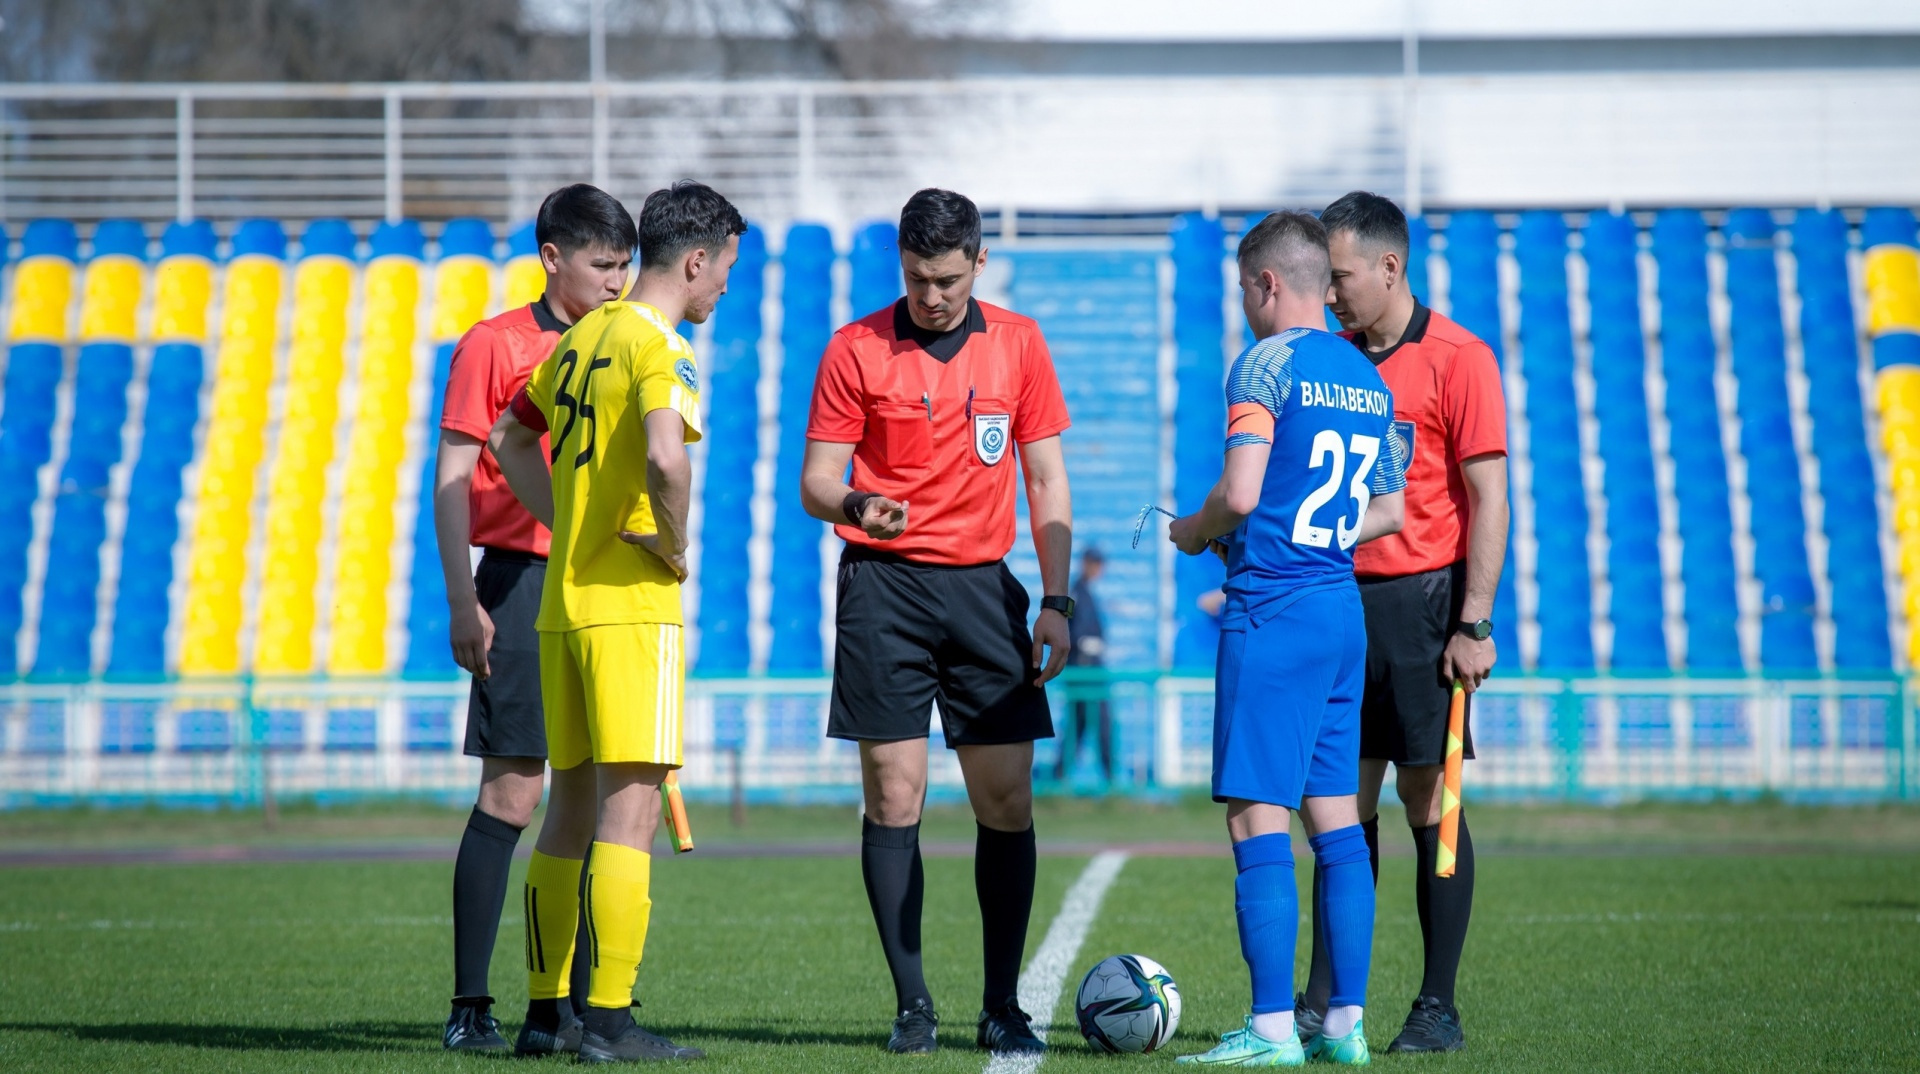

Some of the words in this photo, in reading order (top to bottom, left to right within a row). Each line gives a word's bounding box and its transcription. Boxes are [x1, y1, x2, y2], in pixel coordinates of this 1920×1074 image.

[551, 349, 612, 470] 35
[1300, 381, 1389, 417] BALTABEKOV
[1291, 429, 1381, 551] 23
